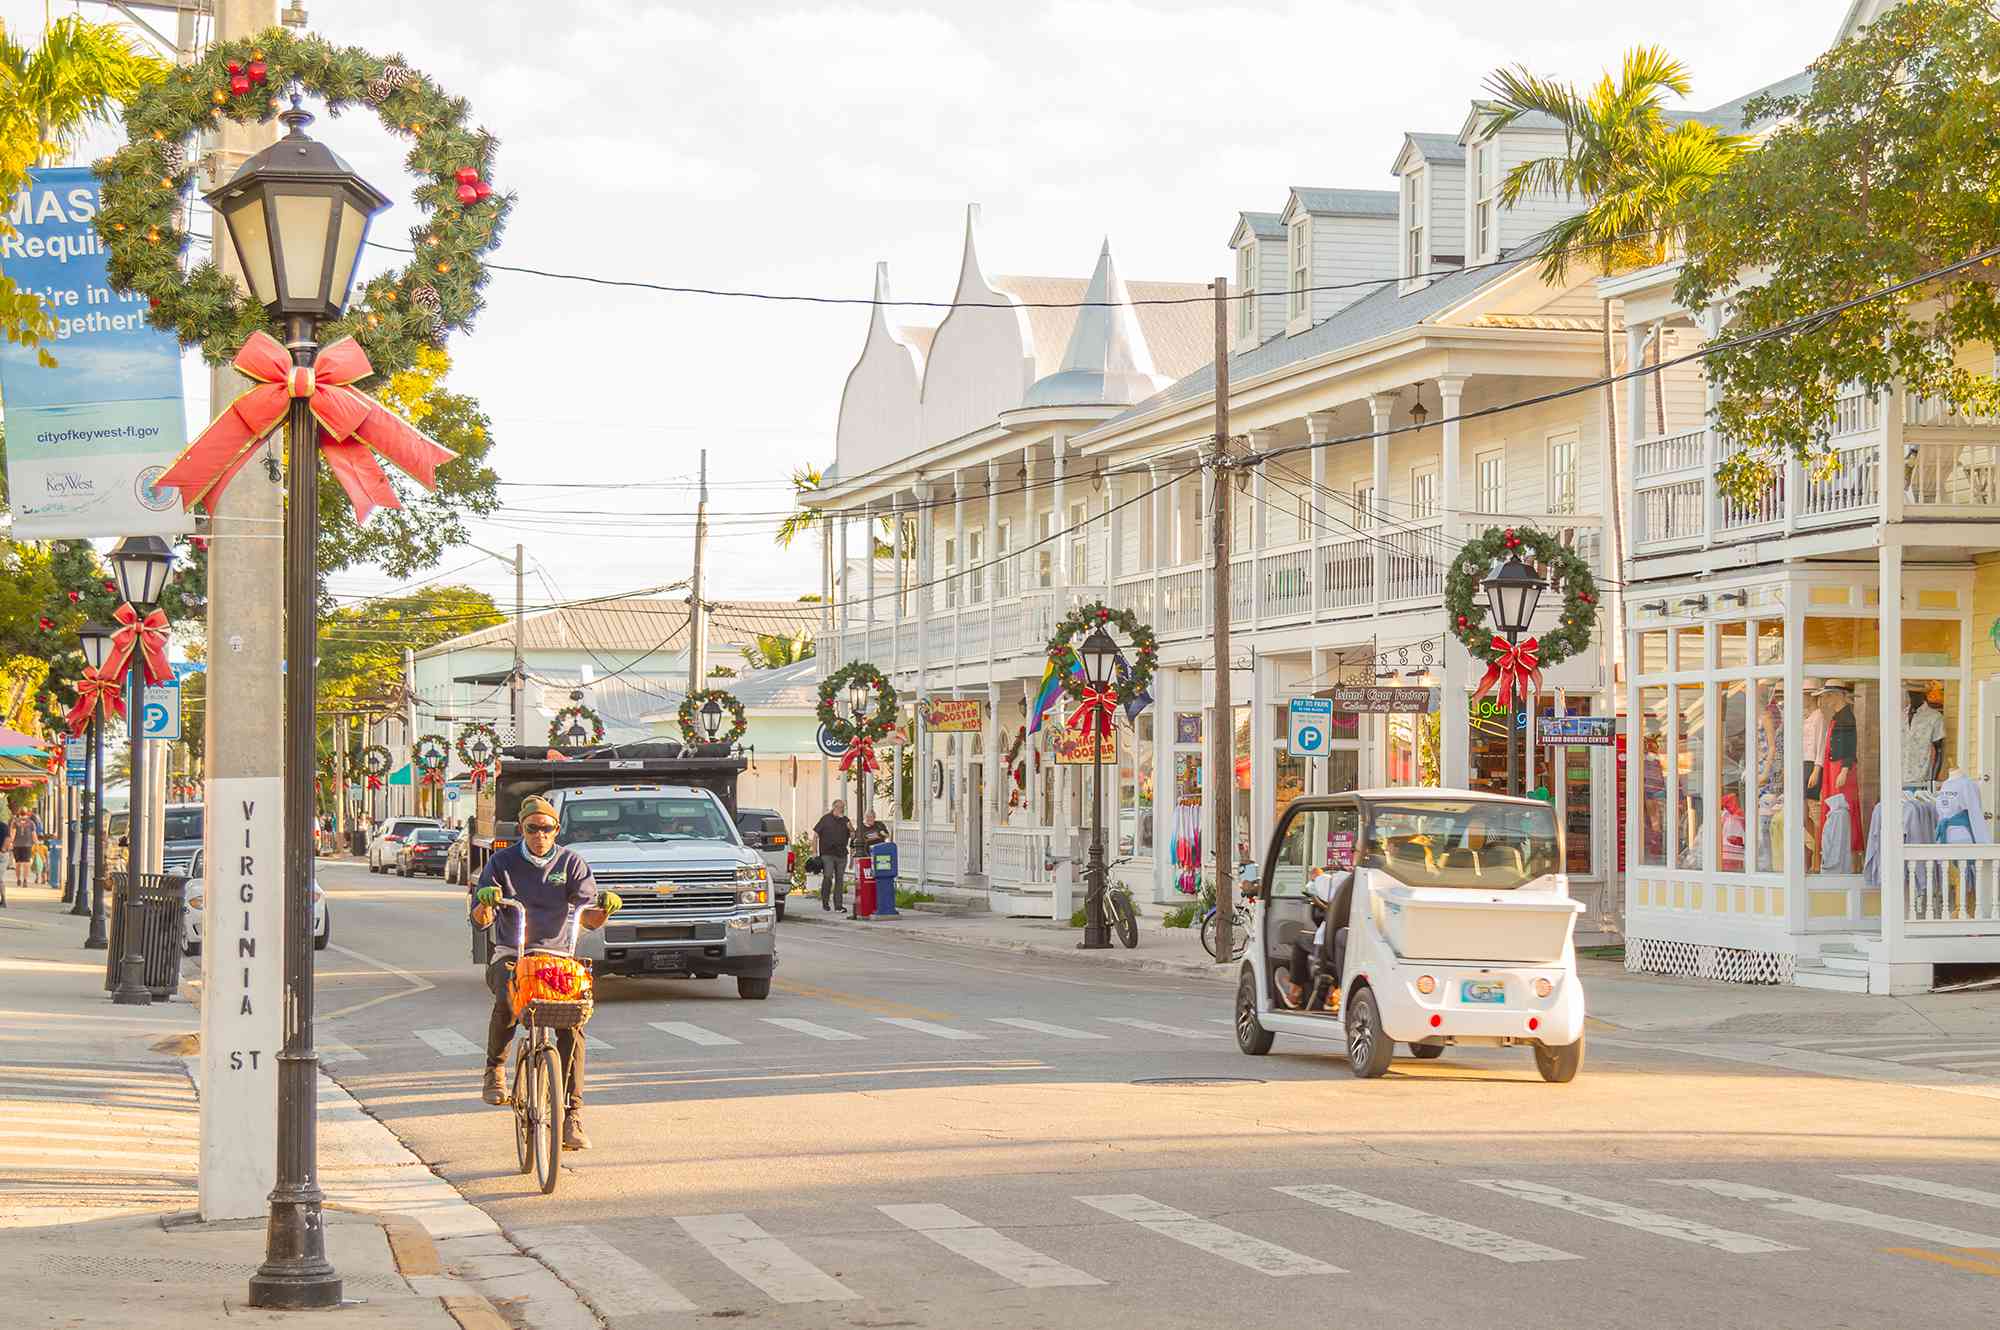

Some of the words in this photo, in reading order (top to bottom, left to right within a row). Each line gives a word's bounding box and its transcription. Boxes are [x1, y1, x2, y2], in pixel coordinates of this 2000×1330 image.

[9, 188, 104, 225] MAS
[13, 286, 79, 307] e're
[86, 284, 110, 305] in
[36, 426, 160, 444] cityofkeywest-fl.gov
[1335, 688, 1365, 700] Island
[1366, 688, 1393, 703] Cigar
[1394, 688, 1429, 703] Factory
[942, 709, 977, 721] OOSTER
[1067, 745, 1114, 760] ROOSER
[239, 800, 256, 1016] VIRGINIA
[230, 1051, 261, 1070] ST
